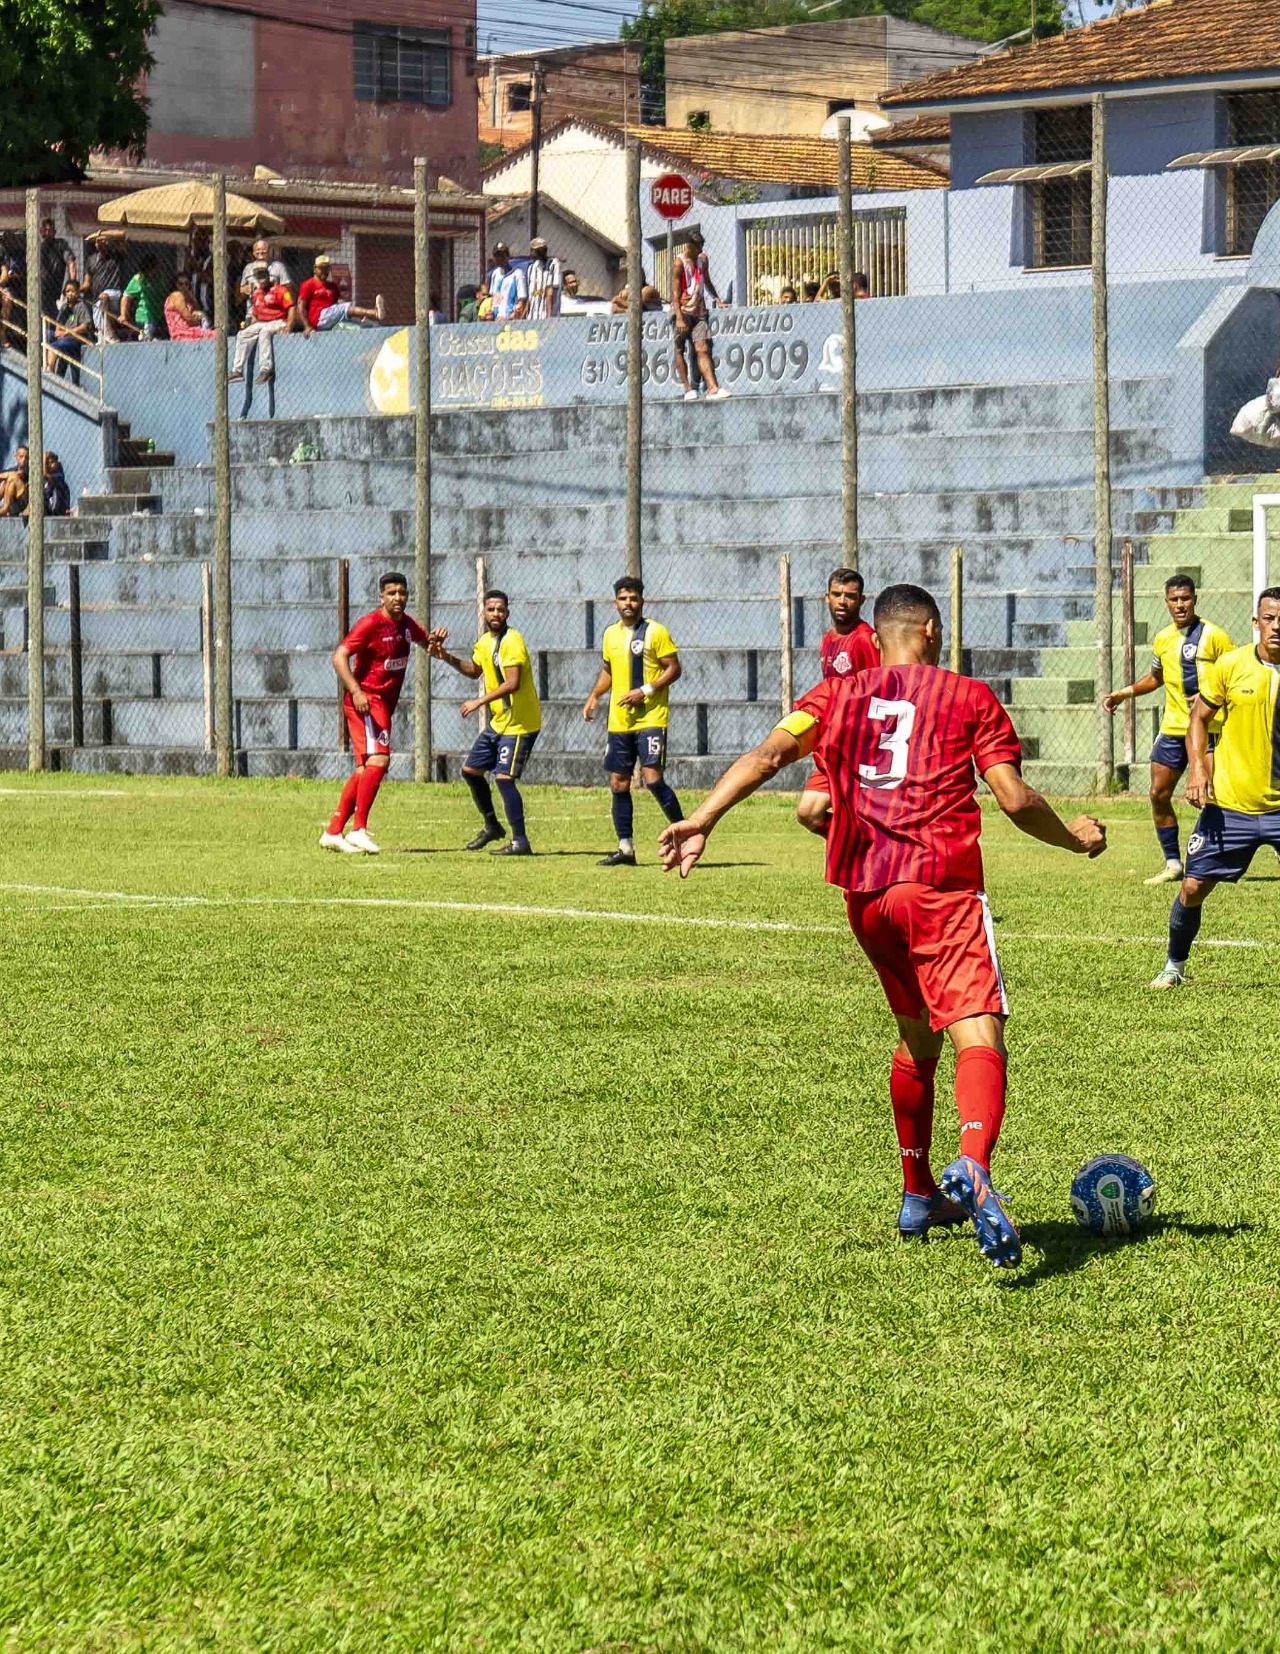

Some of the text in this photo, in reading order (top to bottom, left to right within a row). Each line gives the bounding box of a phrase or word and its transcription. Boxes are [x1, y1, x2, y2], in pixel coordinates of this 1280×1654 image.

[653, 187, 690, 204] PARE
[496, 324, 539, 352] das
[647, 736, 660, 751] 15
[859, 696, 916, 790] 3
[500, 746, 510, 762] 2
